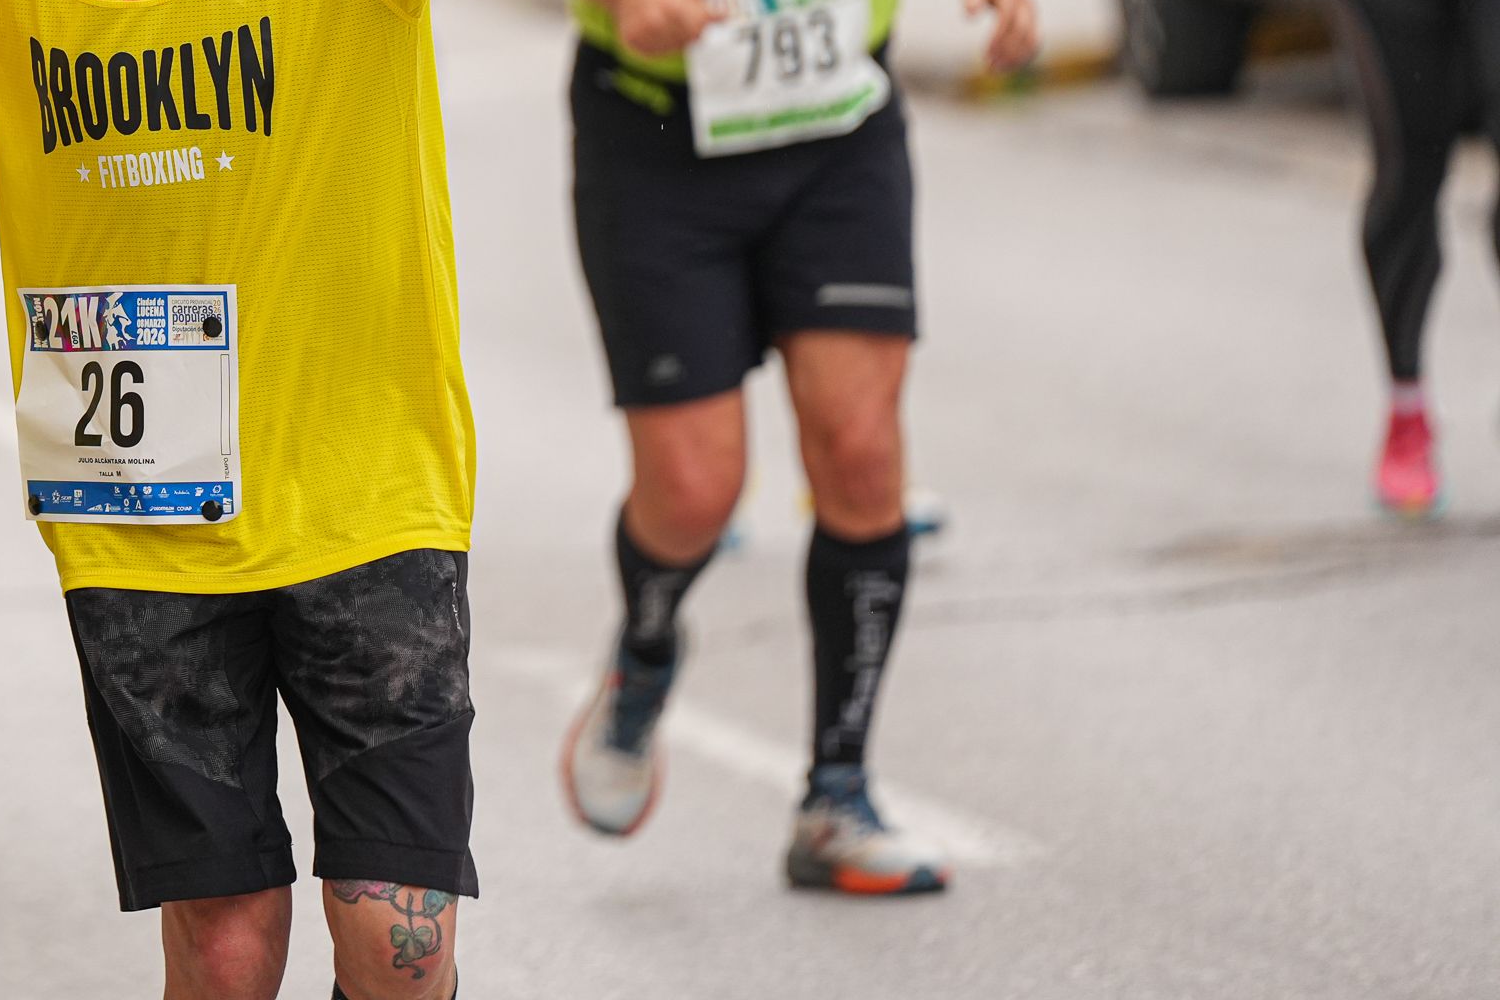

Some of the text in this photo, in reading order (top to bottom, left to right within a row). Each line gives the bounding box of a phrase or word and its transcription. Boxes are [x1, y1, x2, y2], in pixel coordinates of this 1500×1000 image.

[737, 9, 839, 87] 793
[30, 16, 274, 154] BROOKLYN
[97, 147, 205, 188] FITBOXING
[136, 305, 165, 317] LUCENA
[157, 297, 165, 306] de
[171, 304, 214, 314] carreras
[43, 296, 102, 349] 21K
[136, 327, 166, 346] 2026
[74, 360, 145, 448] 26
[94, 457, 126, 465] ALCÁNTARA
